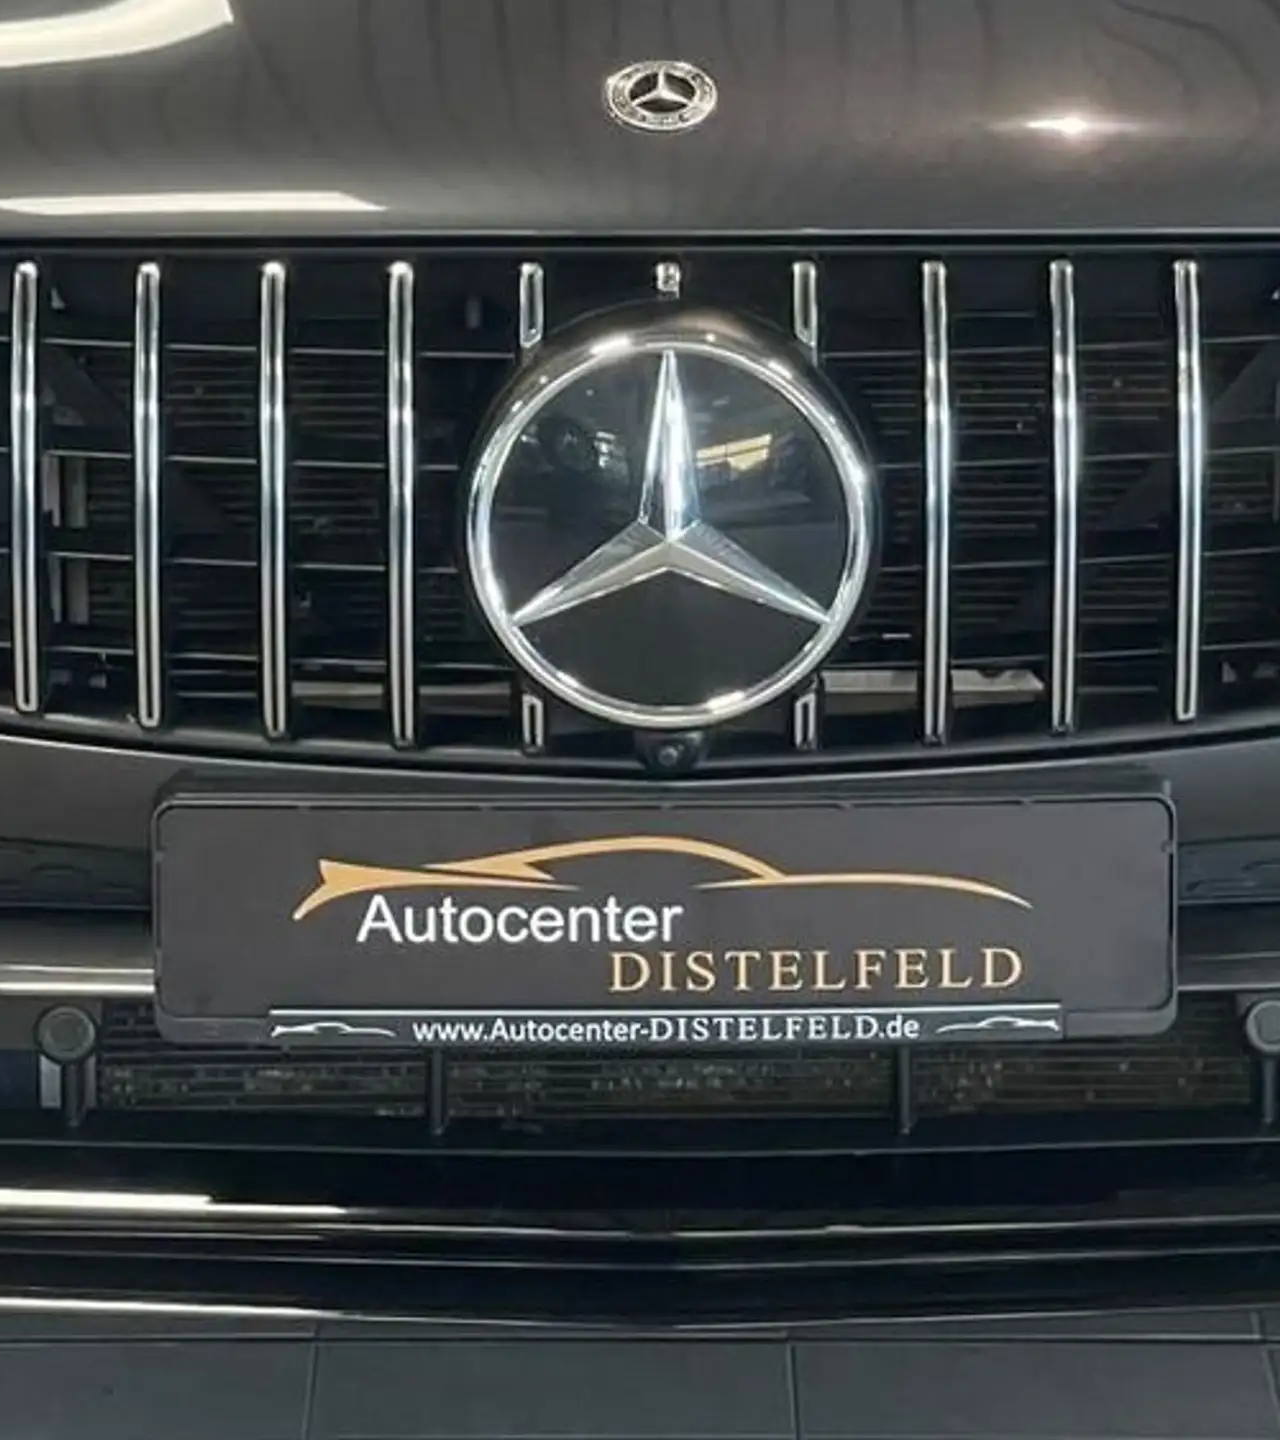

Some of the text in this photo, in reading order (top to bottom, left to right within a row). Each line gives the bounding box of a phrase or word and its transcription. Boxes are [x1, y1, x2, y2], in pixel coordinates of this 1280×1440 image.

[356, 894, 683, 943] Autocenter
[608, 947, 1023, 993] DISTELFELD
[412, 1014, 920, 1043] www.Autocenter-DISTELFELD.de
